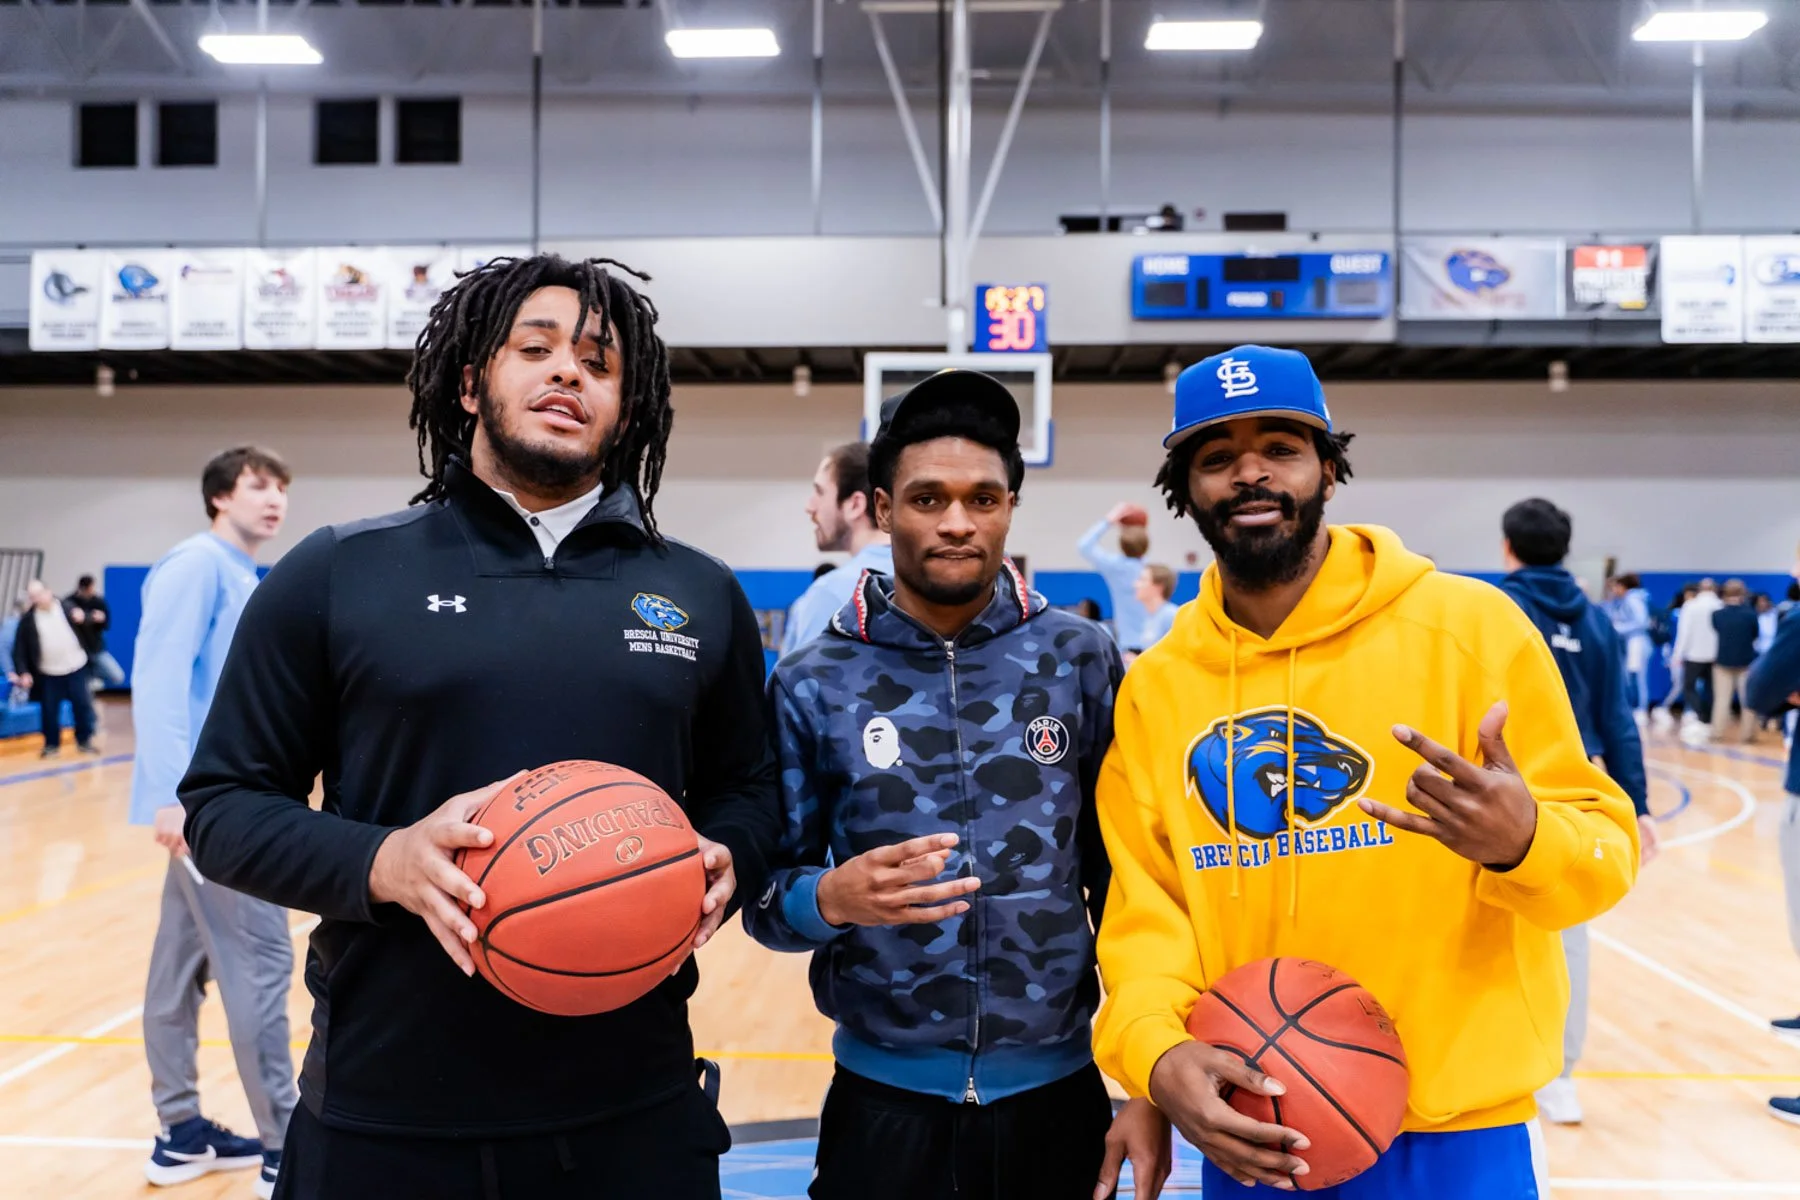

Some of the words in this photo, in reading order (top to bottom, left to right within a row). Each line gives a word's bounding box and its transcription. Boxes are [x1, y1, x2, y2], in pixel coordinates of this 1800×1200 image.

[1143, 255, 1189, 275] HOME
[1330, 254, 1382, 274] GUEST
[988, 310, 1035, 351] 30
[623, 629, 658, 640] BRESCIA
[660, 631, 699, 649] UNIVERSITY
[629, 641, 653, 652] MENS
[655, 643, 697, 661] BASKETBALL
[1030, 719, 1061, 732] PARIS
[1275, 820, 1394, 857] BASEBALL
